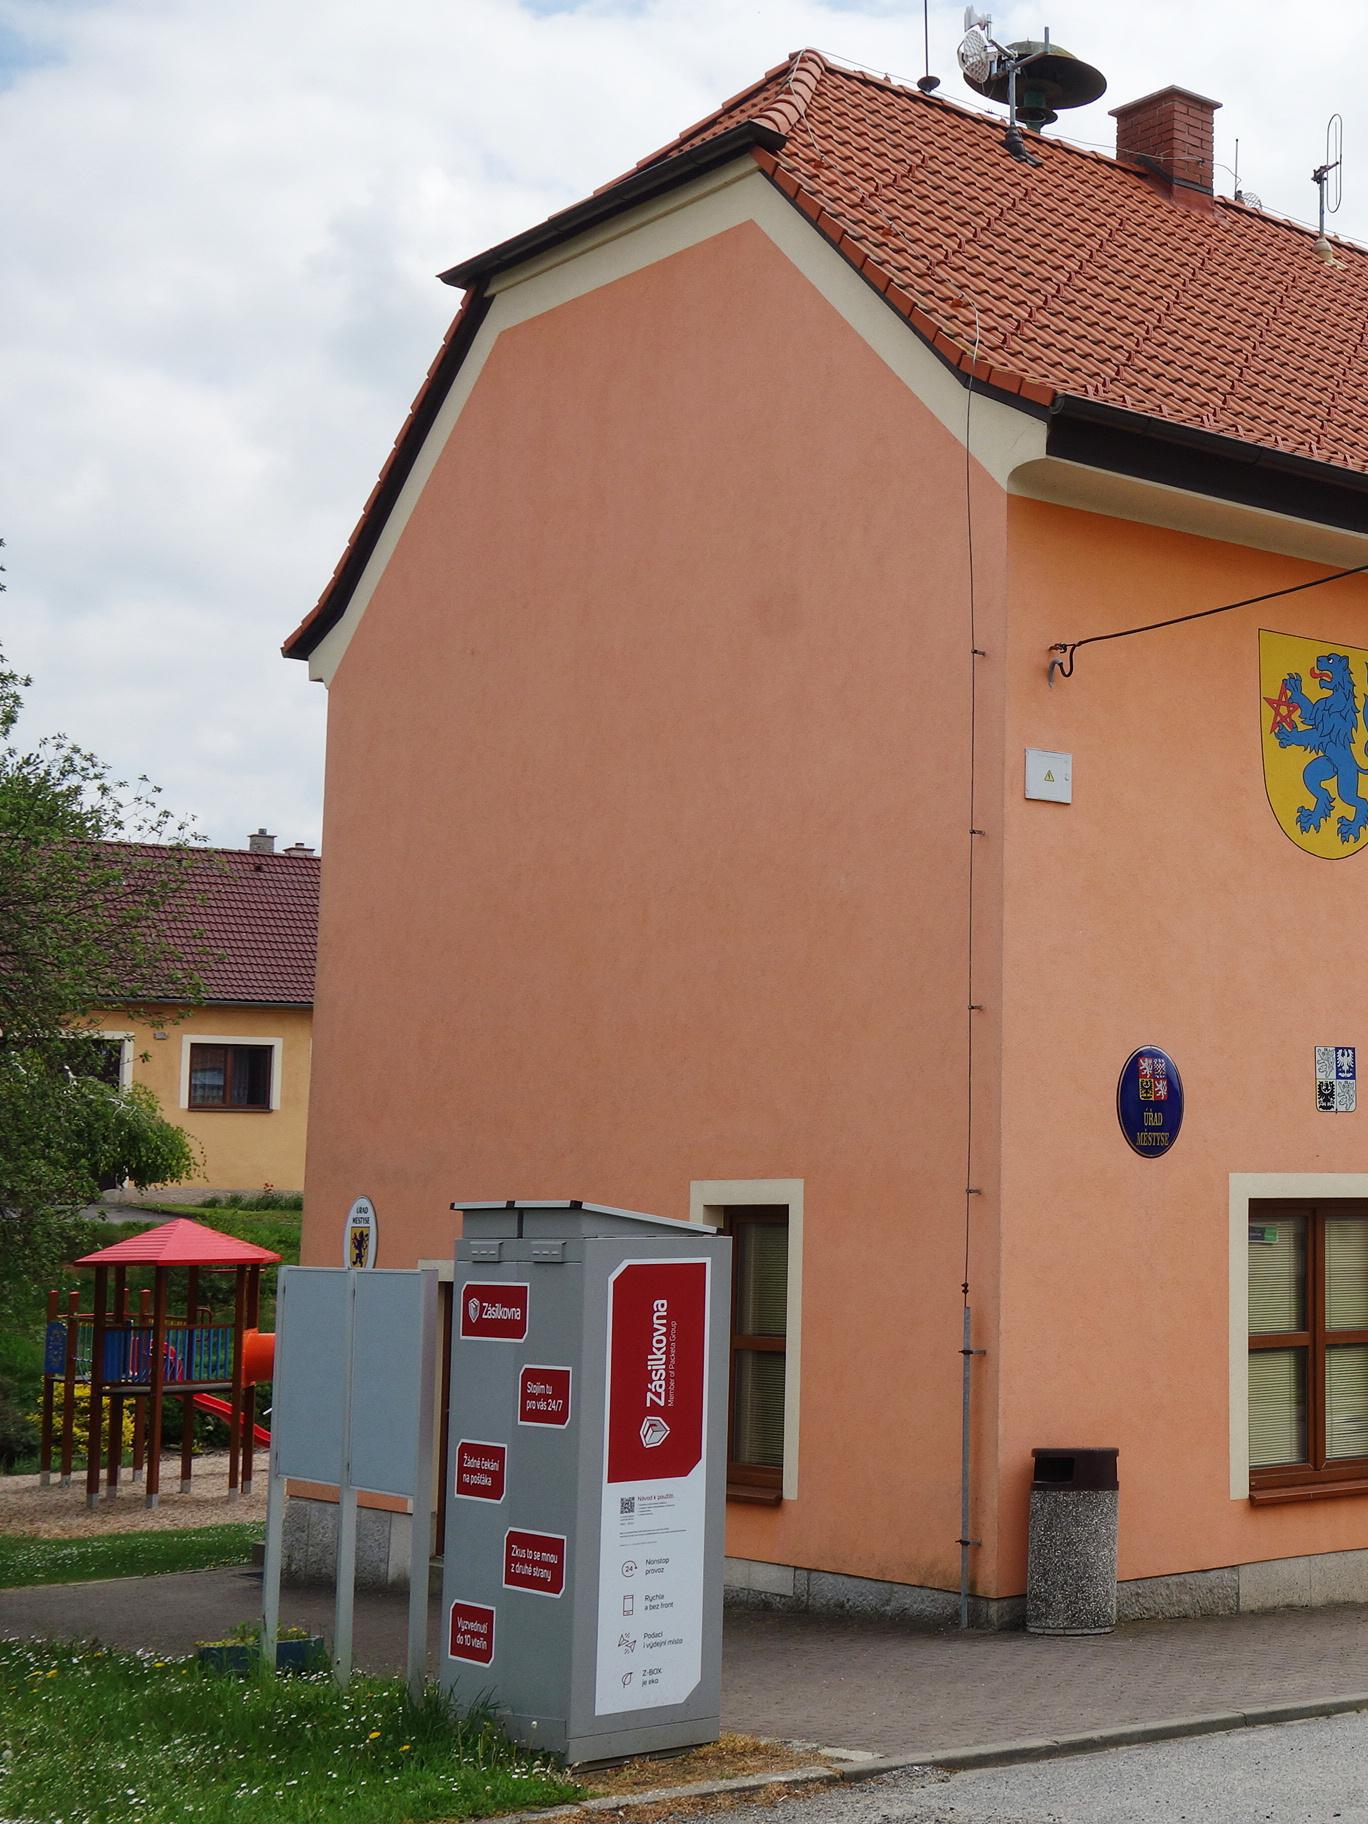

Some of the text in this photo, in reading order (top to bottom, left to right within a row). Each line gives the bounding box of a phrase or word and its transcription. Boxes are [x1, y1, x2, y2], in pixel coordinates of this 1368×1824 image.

[482, 1302, 521, 1320] Zásilkovna
[646, 1299, 668, 1407] Zásilkovna
[526, 1381, 553, 1396] Stojím tu
[526, 1398, 563, 1412] pro vás 24/7
[463, 1474, 470, 1483] na
[511, 1544, 558, 1564] Zkus to se mnou
[511, 1562, 552, 1582] z druhé strany
[457, 1616, 488, 1634] Vyzvednutí
[456, 1633, 464, 1645] do
[464, 1634, 471, 1646] 10
